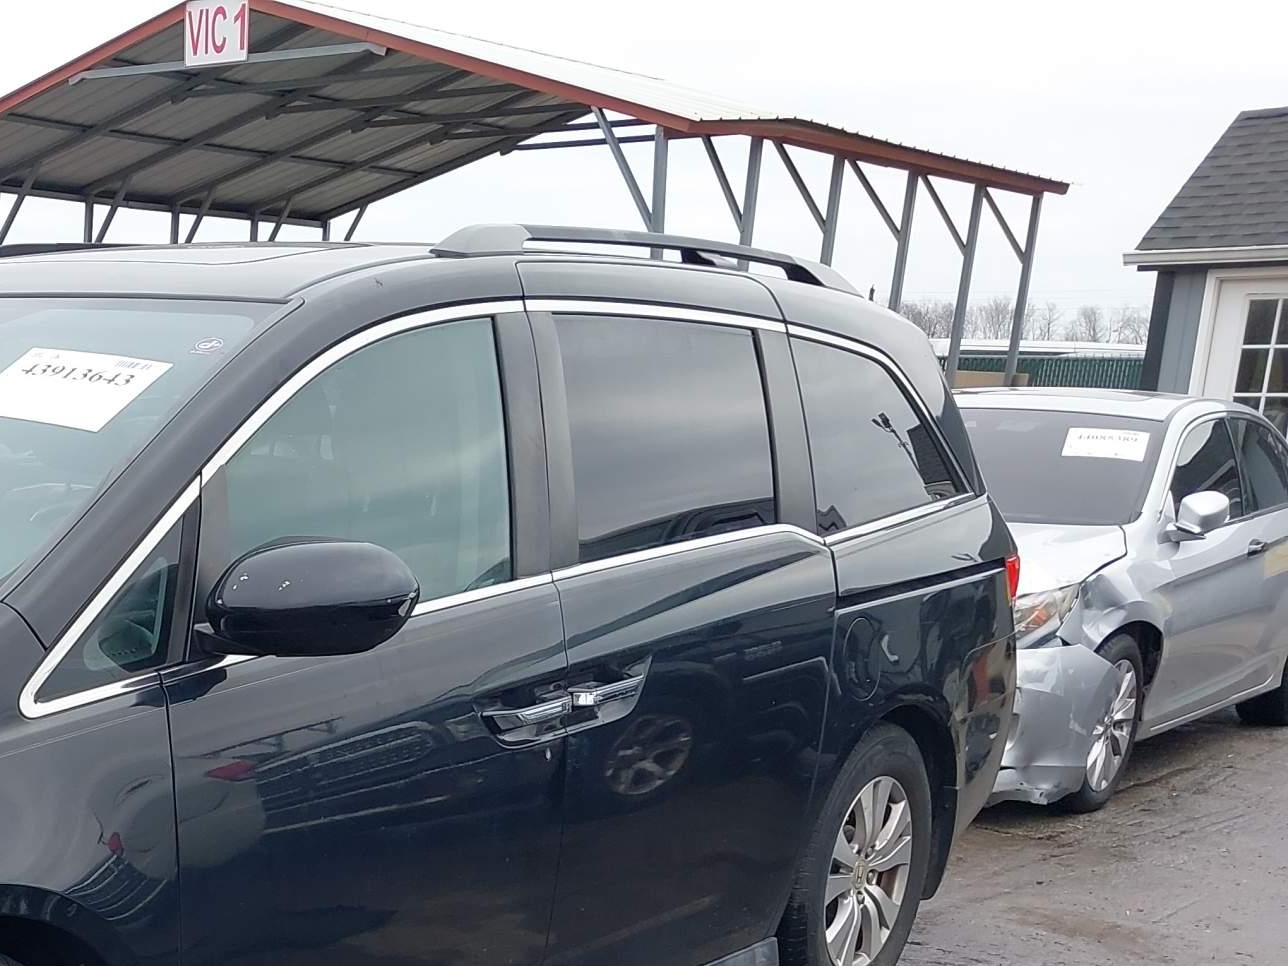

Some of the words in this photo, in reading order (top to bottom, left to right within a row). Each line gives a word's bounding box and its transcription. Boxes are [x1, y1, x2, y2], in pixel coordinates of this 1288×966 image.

[187, 5, 228, 56] VIC
[233, 3, 247, 51] 1
[22, 363, 136, 386] 43913643
